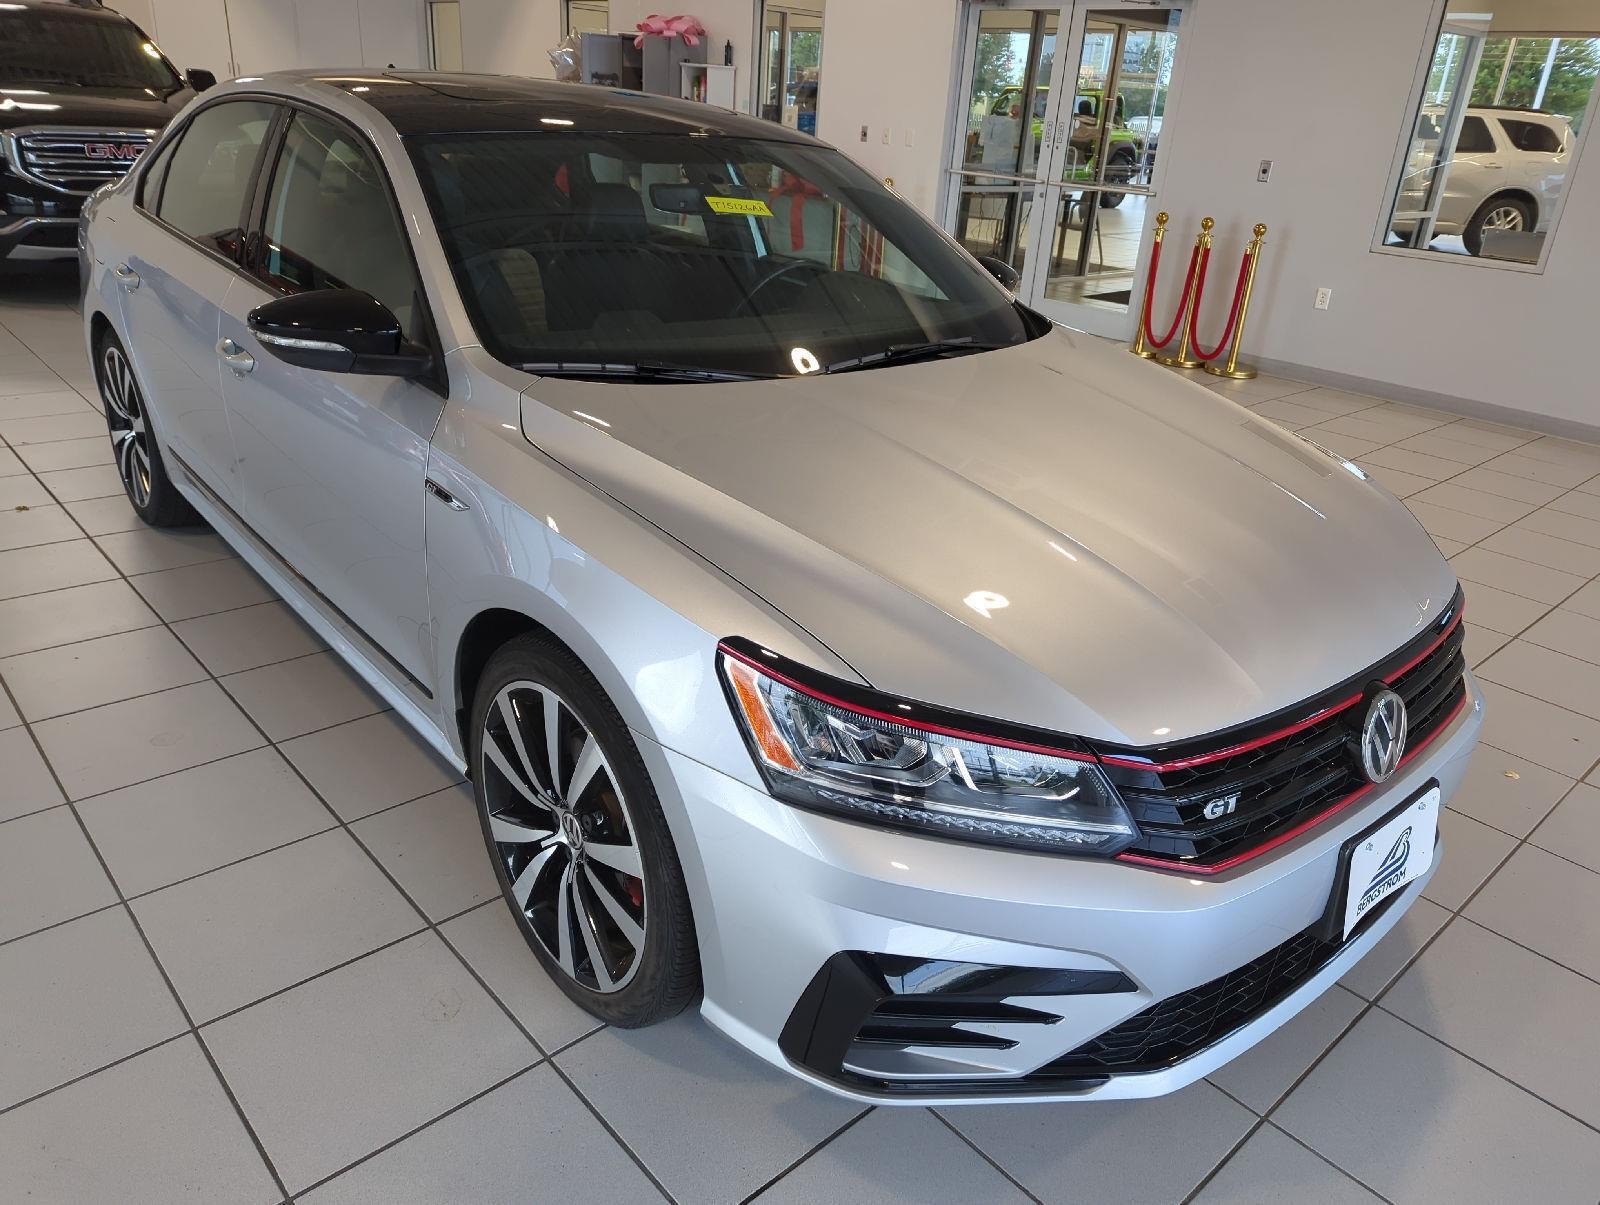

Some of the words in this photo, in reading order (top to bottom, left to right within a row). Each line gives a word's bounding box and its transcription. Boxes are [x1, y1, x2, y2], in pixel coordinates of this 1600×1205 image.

[84, 143, 148, 159] GMC
[1203, 791, 1241, 820] GT
[1356, 867, 1407, 917] BERGSTROM
